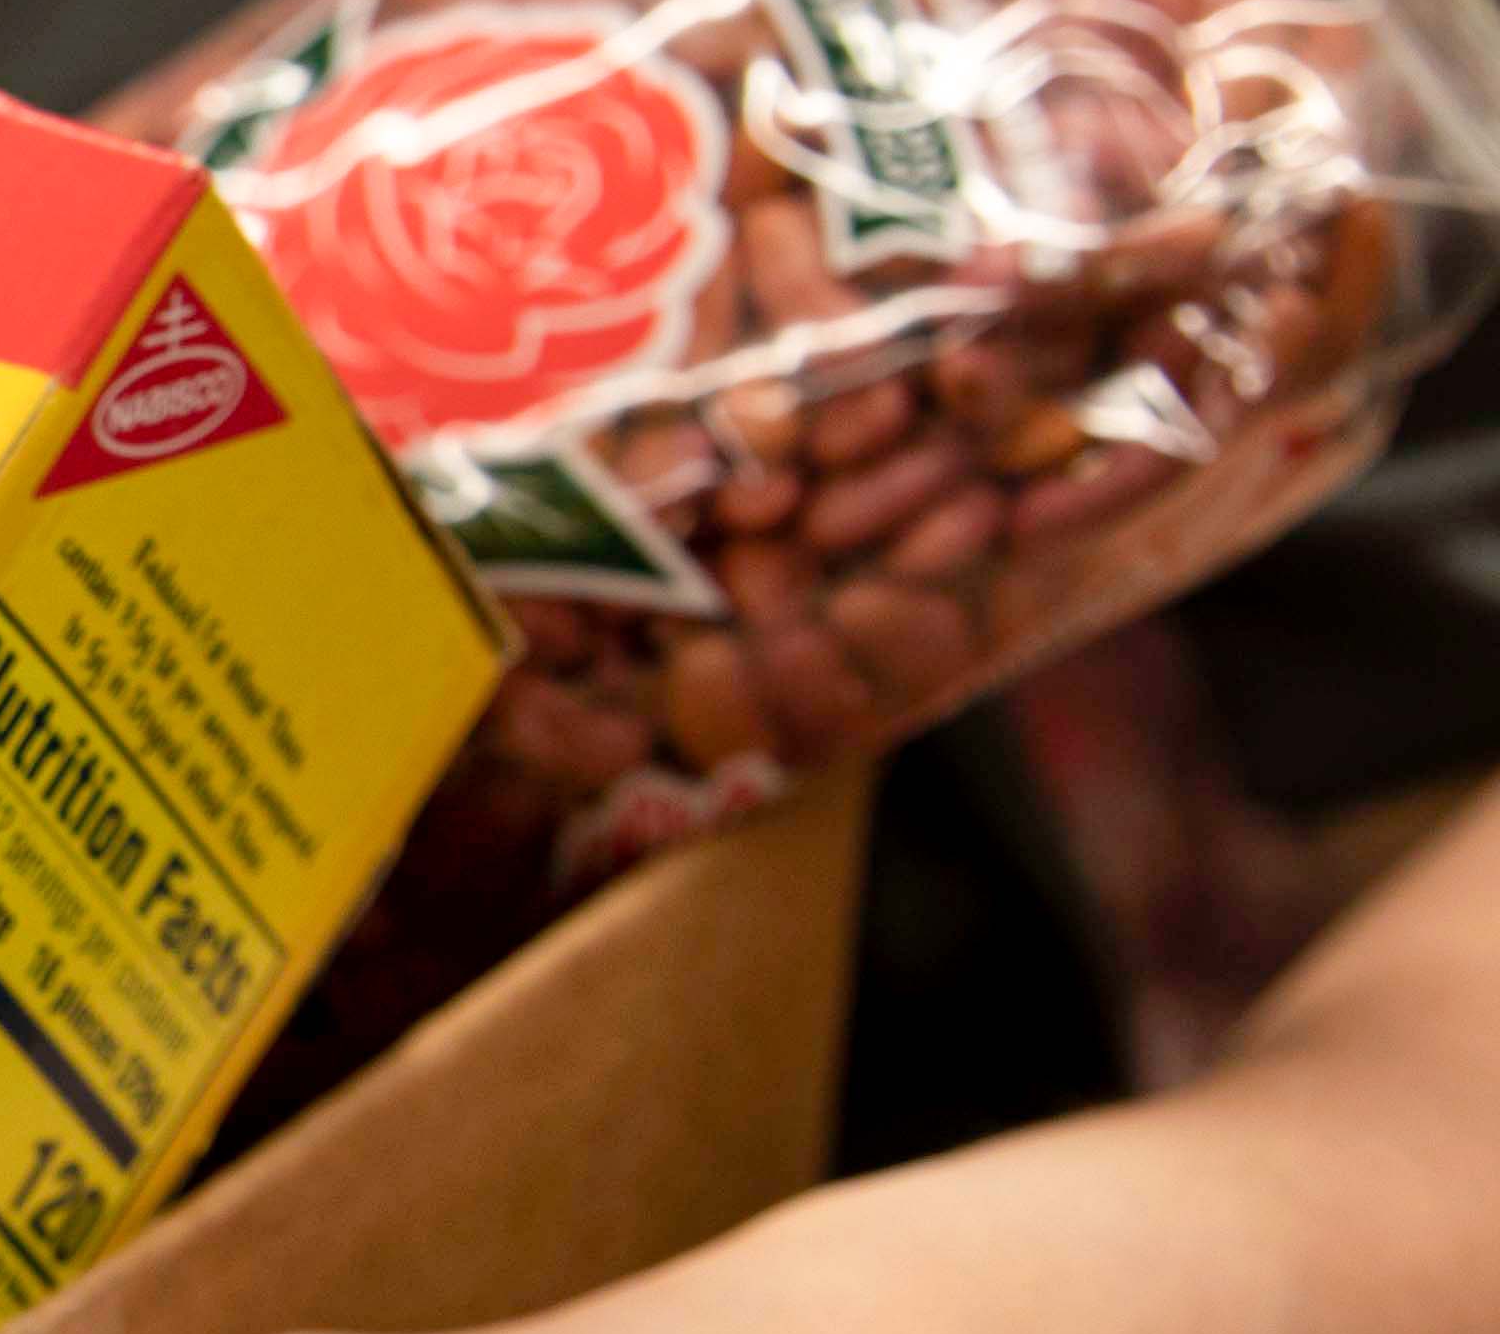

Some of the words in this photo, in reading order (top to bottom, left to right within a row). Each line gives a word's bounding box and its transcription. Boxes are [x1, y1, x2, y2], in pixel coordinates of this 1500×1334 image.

[104, 367, 235, 436] NABISCO
[138, 853, 247, 1014] Facts
[15, 1142, 106, 1267] 120
